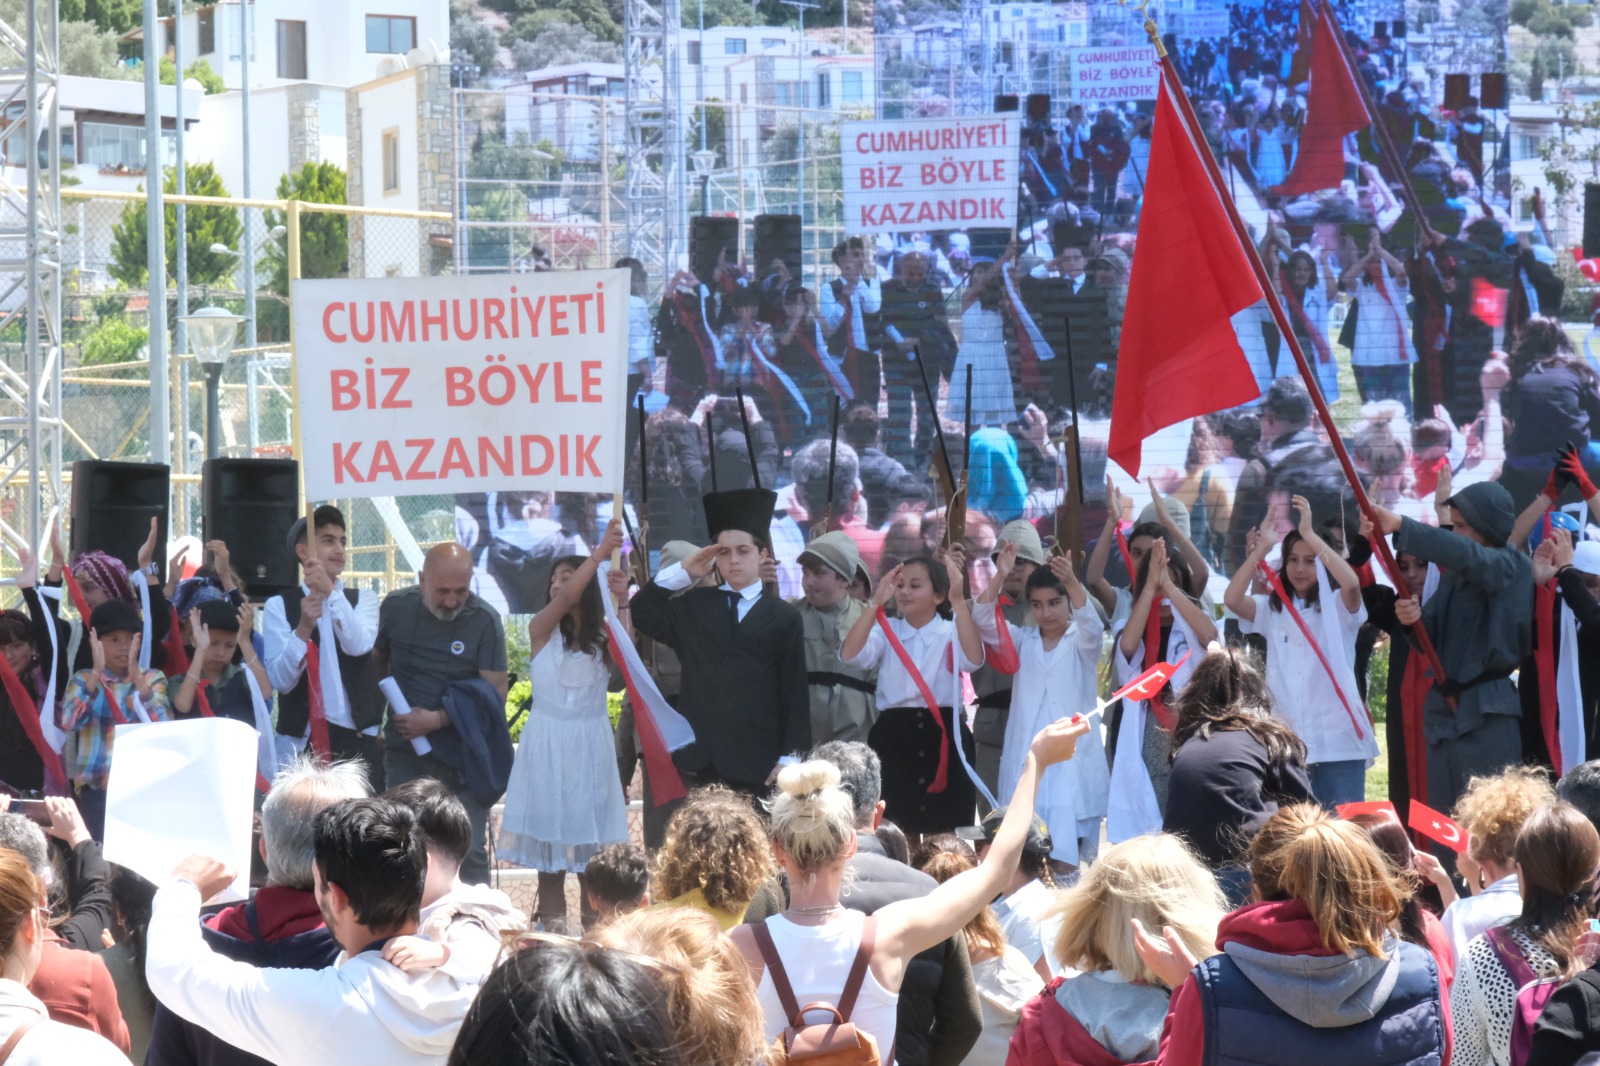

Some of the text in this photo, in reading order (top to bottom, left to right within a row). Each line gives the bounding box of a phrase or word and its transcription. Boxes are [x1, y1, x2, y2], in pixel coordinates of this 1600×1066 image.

[1079, 65, 1153, 81] BİZ BÖYLE
[1079, 85, 1153, 99] KAZANDIK
[857, 118, 1006, 154] CUMHURİYETİ
[860, 156, 1005, 189] BİZ BÖYLE
[861, 197, 1005, 226] KAZANDIK
[322, 281, 606, 339] CUMHURİYETİ
[330, 353, 603, 411] BİZ BÖYLE
[332, 434, 603, 485] KAZANDIK
